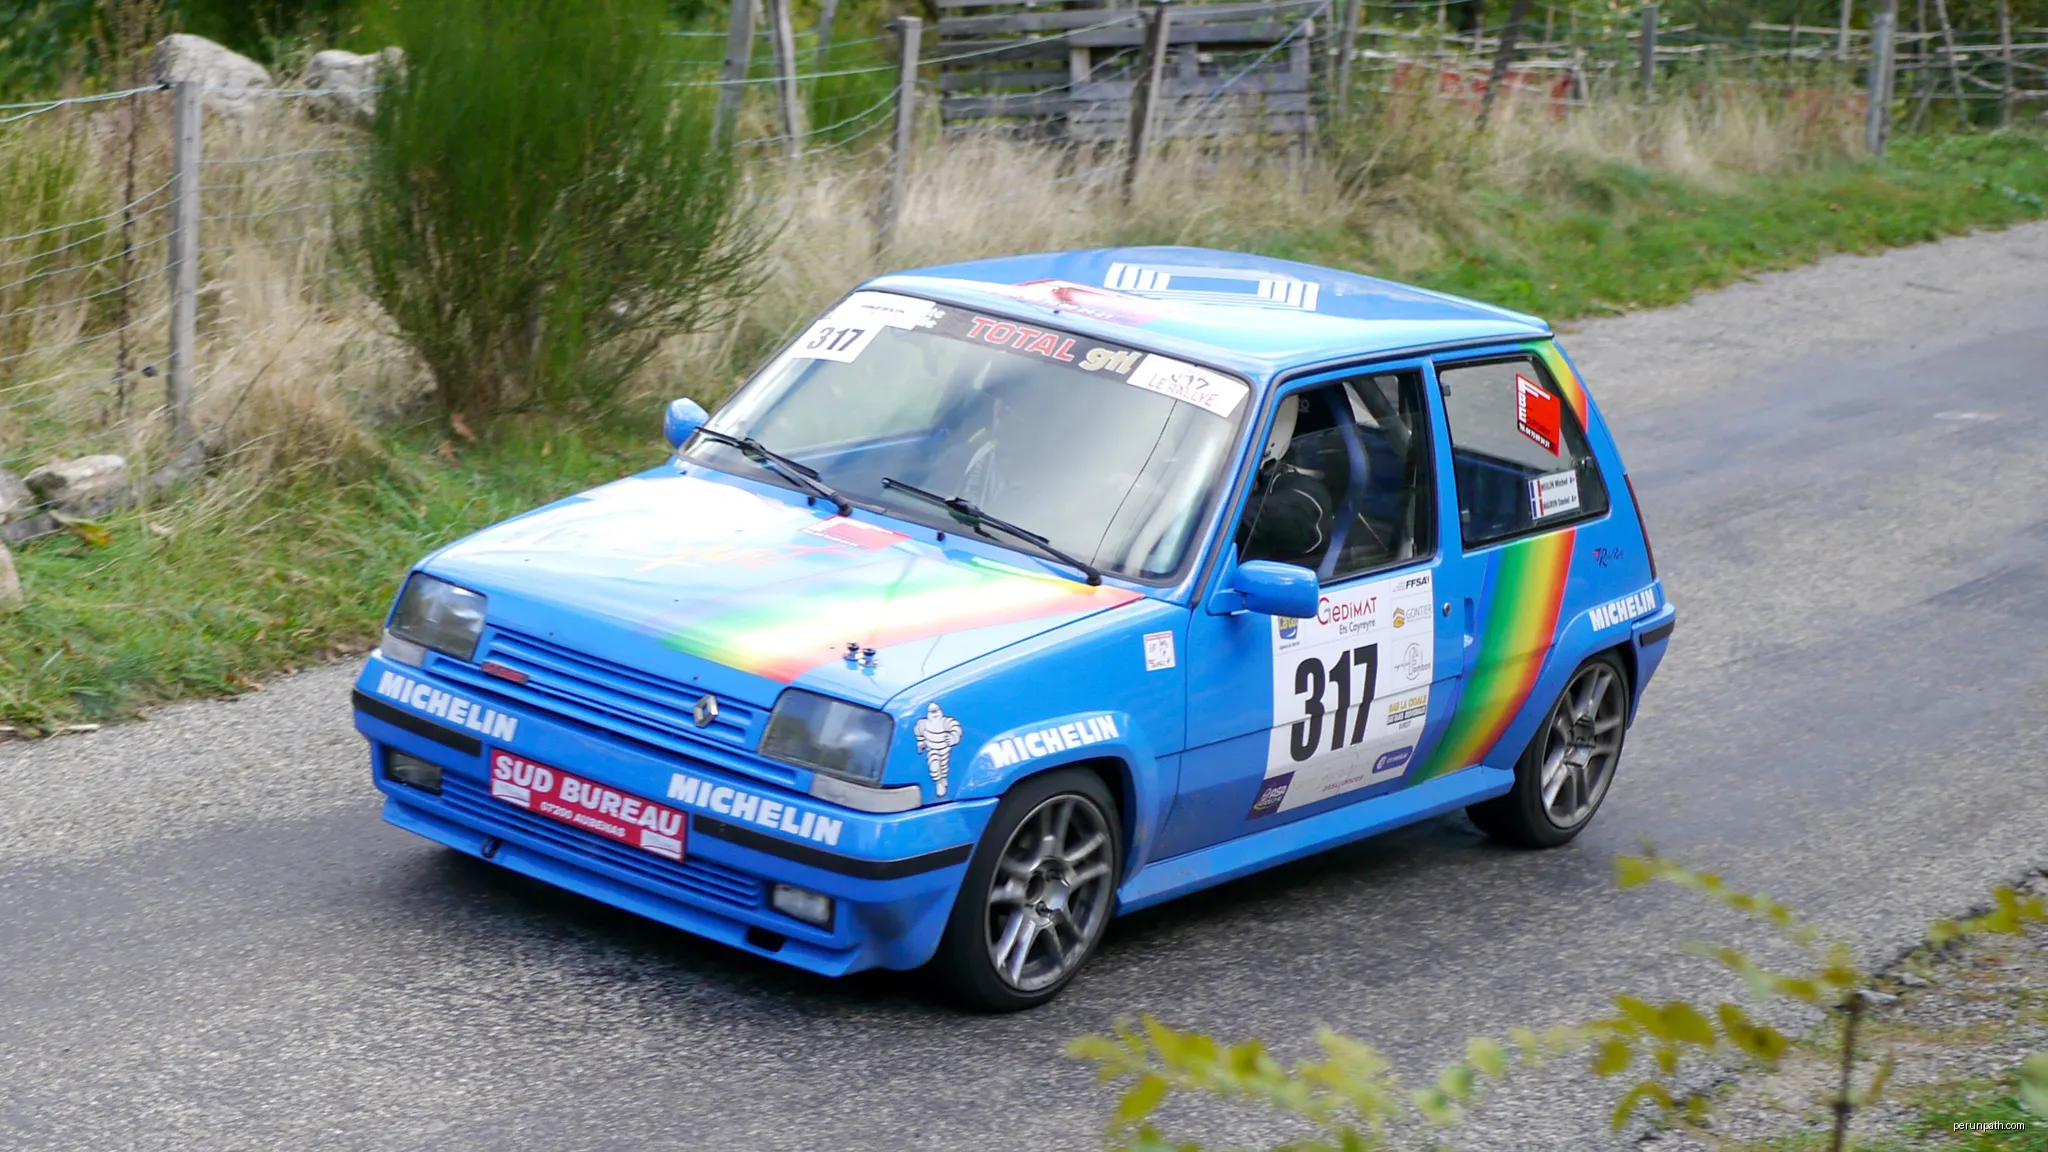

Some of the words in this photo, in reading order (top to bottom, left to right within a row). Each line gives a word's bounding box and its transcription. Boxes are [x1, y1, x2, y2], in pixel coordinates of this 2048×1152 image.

[806, 326, 866, 352] 317
[966, 316, 1076, 362] TOTAL
[1166, 382, 1220, 408] RALLYE
[1405, 576, 1427, 589] FFSA
[1588, 589, 1656, 632] MICHELIN
[376, 671, 519, 743] MICHELIN
[1290, 642, 1378, 763] 317
[990, 714, 1121, 770] MICHELIN
[494, 755, 554, 793] SUD
[559, 776, 683, 837] BUREAU
[667, 772, 844, 846] MICHELIN
